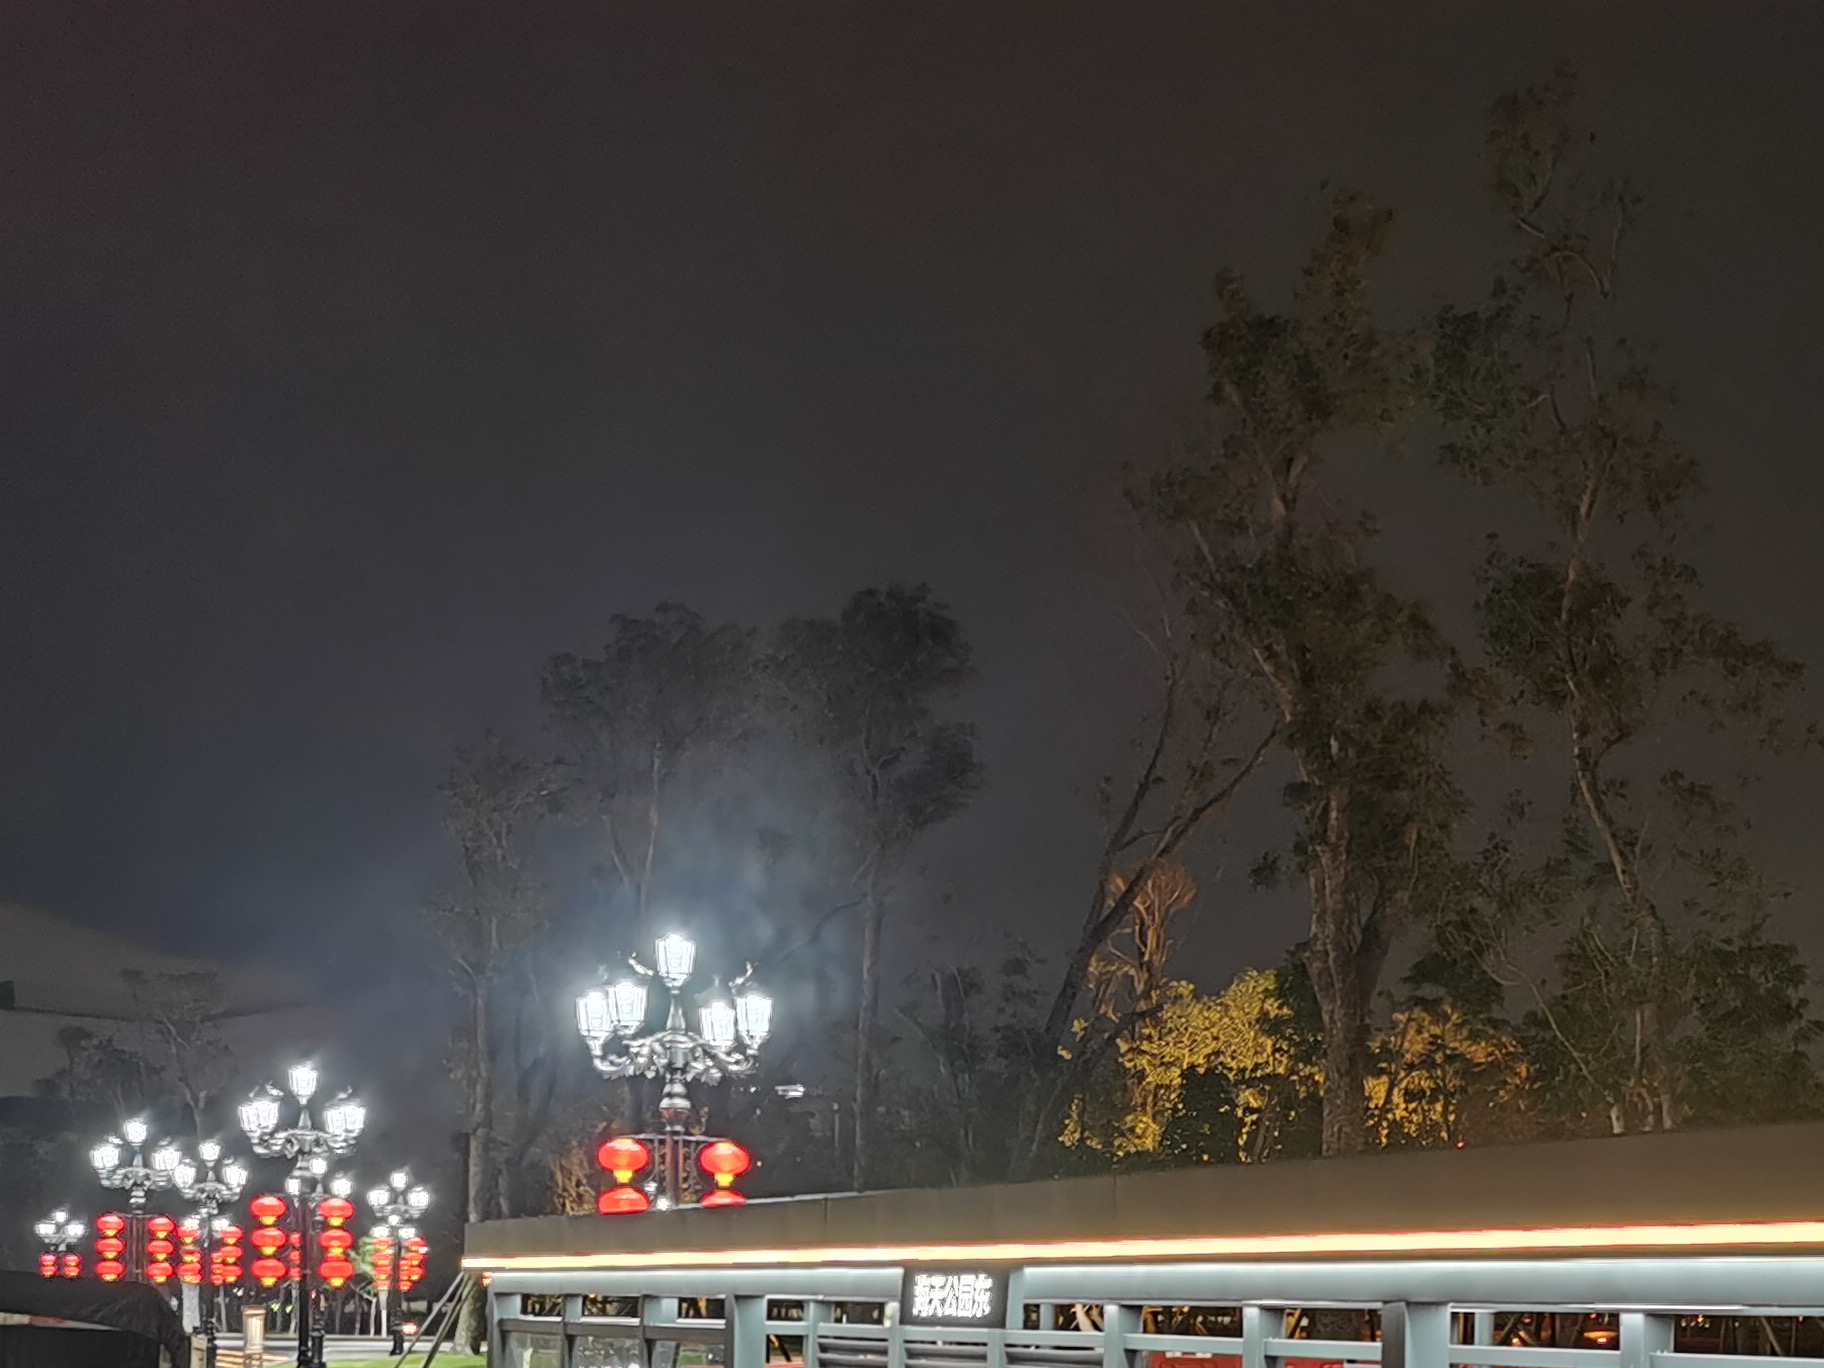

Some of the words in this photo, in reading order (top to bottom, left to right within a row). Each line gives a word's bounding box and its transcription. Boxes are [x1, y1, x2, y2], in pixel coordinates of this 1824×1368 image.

[913, 1272, 993, 1318] 海天公园东
